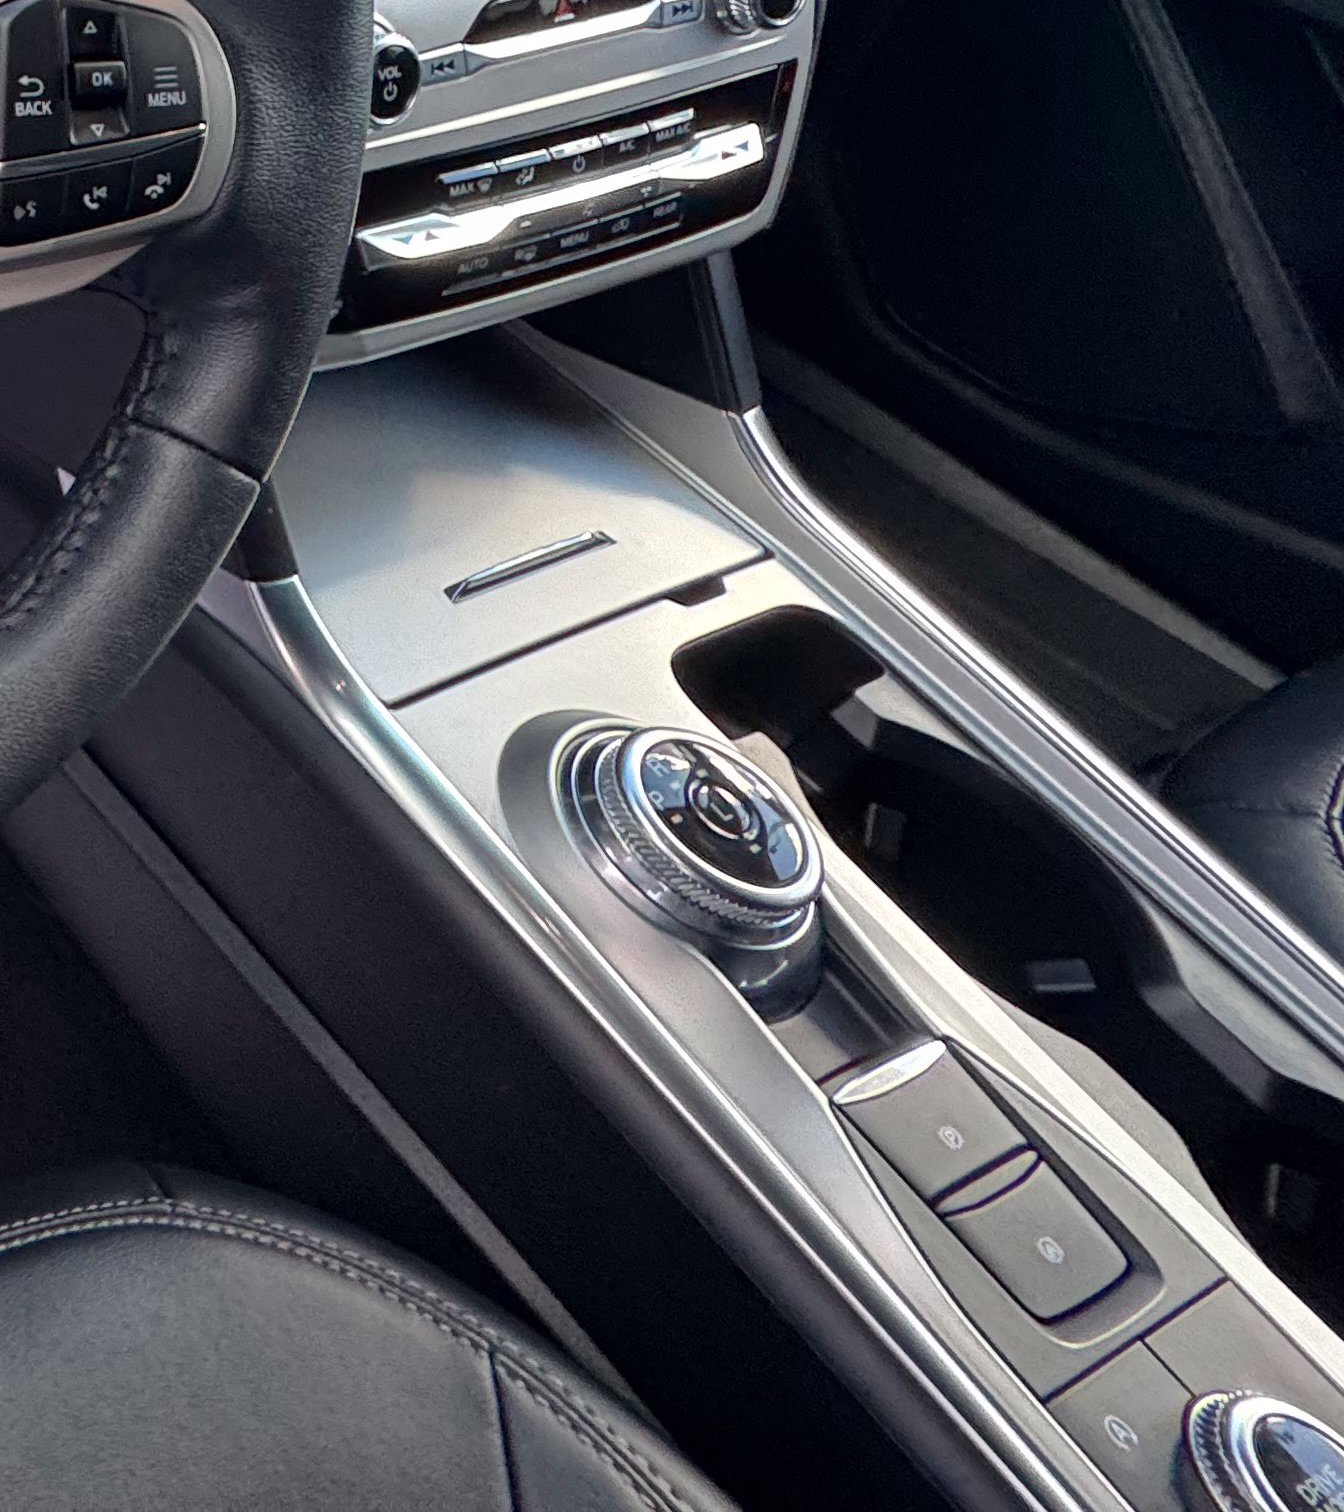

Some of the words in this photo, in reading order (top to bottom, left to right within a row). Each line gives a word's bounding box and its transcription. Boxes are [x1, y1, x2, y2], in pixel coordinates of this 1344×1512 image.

[91, 71, 113, 88] OK
[378, 65, 403, 82] VOL
[147, 90, 186, 107] MENU
[15, 100, 52, 117] BACK
[449, 180, 475, 198] MAX
[457, 257, 489, 274] AUTO
[1296, 1462, 1344, 1508] DRIVE
